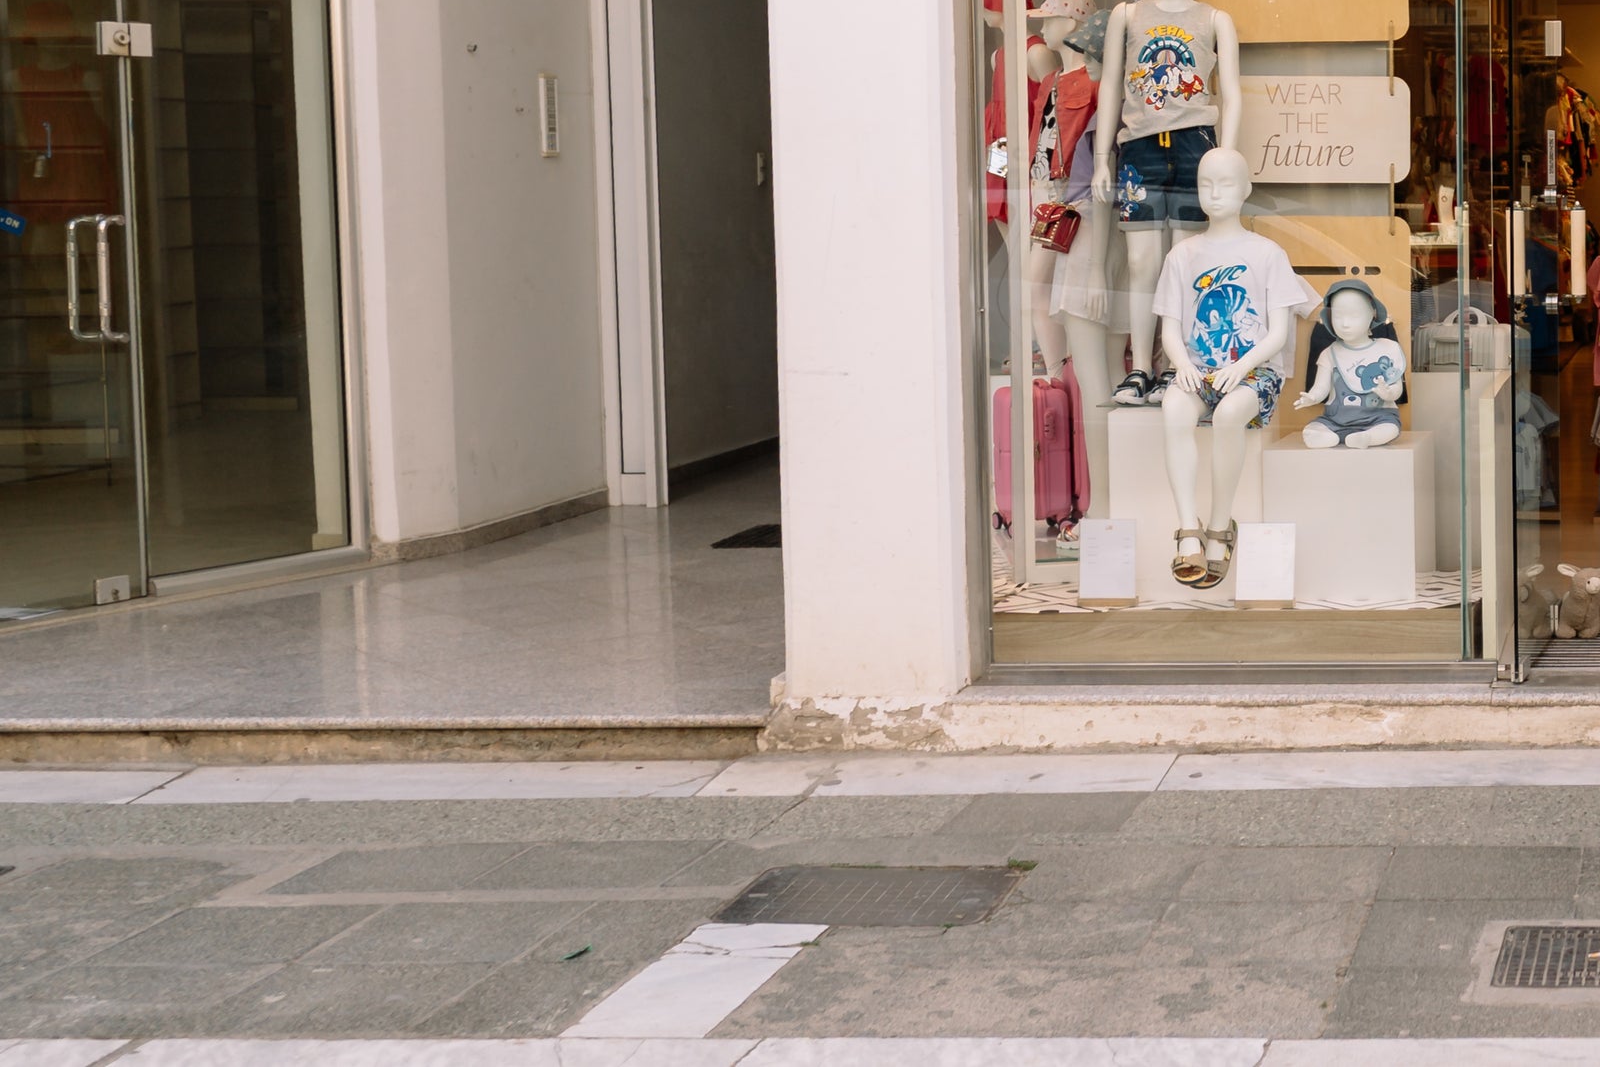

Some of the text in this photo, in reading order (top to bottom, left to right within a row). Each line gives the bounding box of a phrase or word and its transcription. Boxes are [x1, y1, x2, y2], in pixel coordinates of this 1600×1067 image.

[1145, 24, 1195, 43] TEAM
[1264, 82, 1343, 105] WEAR
[1278, 112, 1329, 134] THE
[1253, 134, 1355, 176] future
